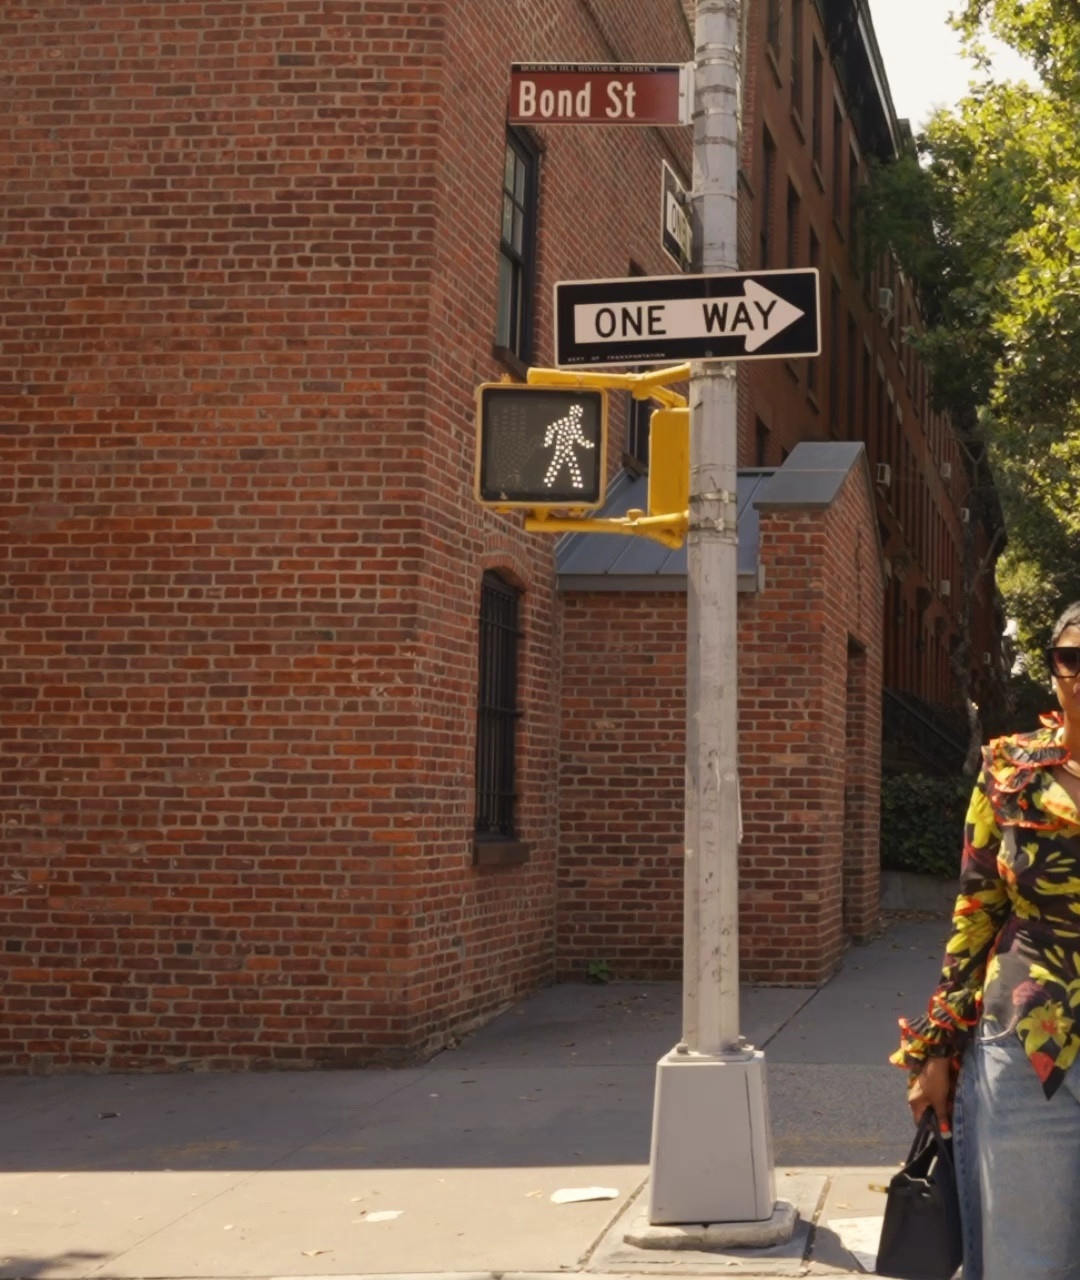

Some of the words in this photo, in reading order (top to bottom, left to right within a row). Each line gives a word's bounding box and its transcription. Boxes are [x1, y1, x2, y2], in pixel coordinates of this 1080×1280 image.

[519, 80, 591, 117] Bond
[605, 80, 636, 118] St
[595, 305, 666, 338] ONE
[703, 300, 777, 333] WAY
